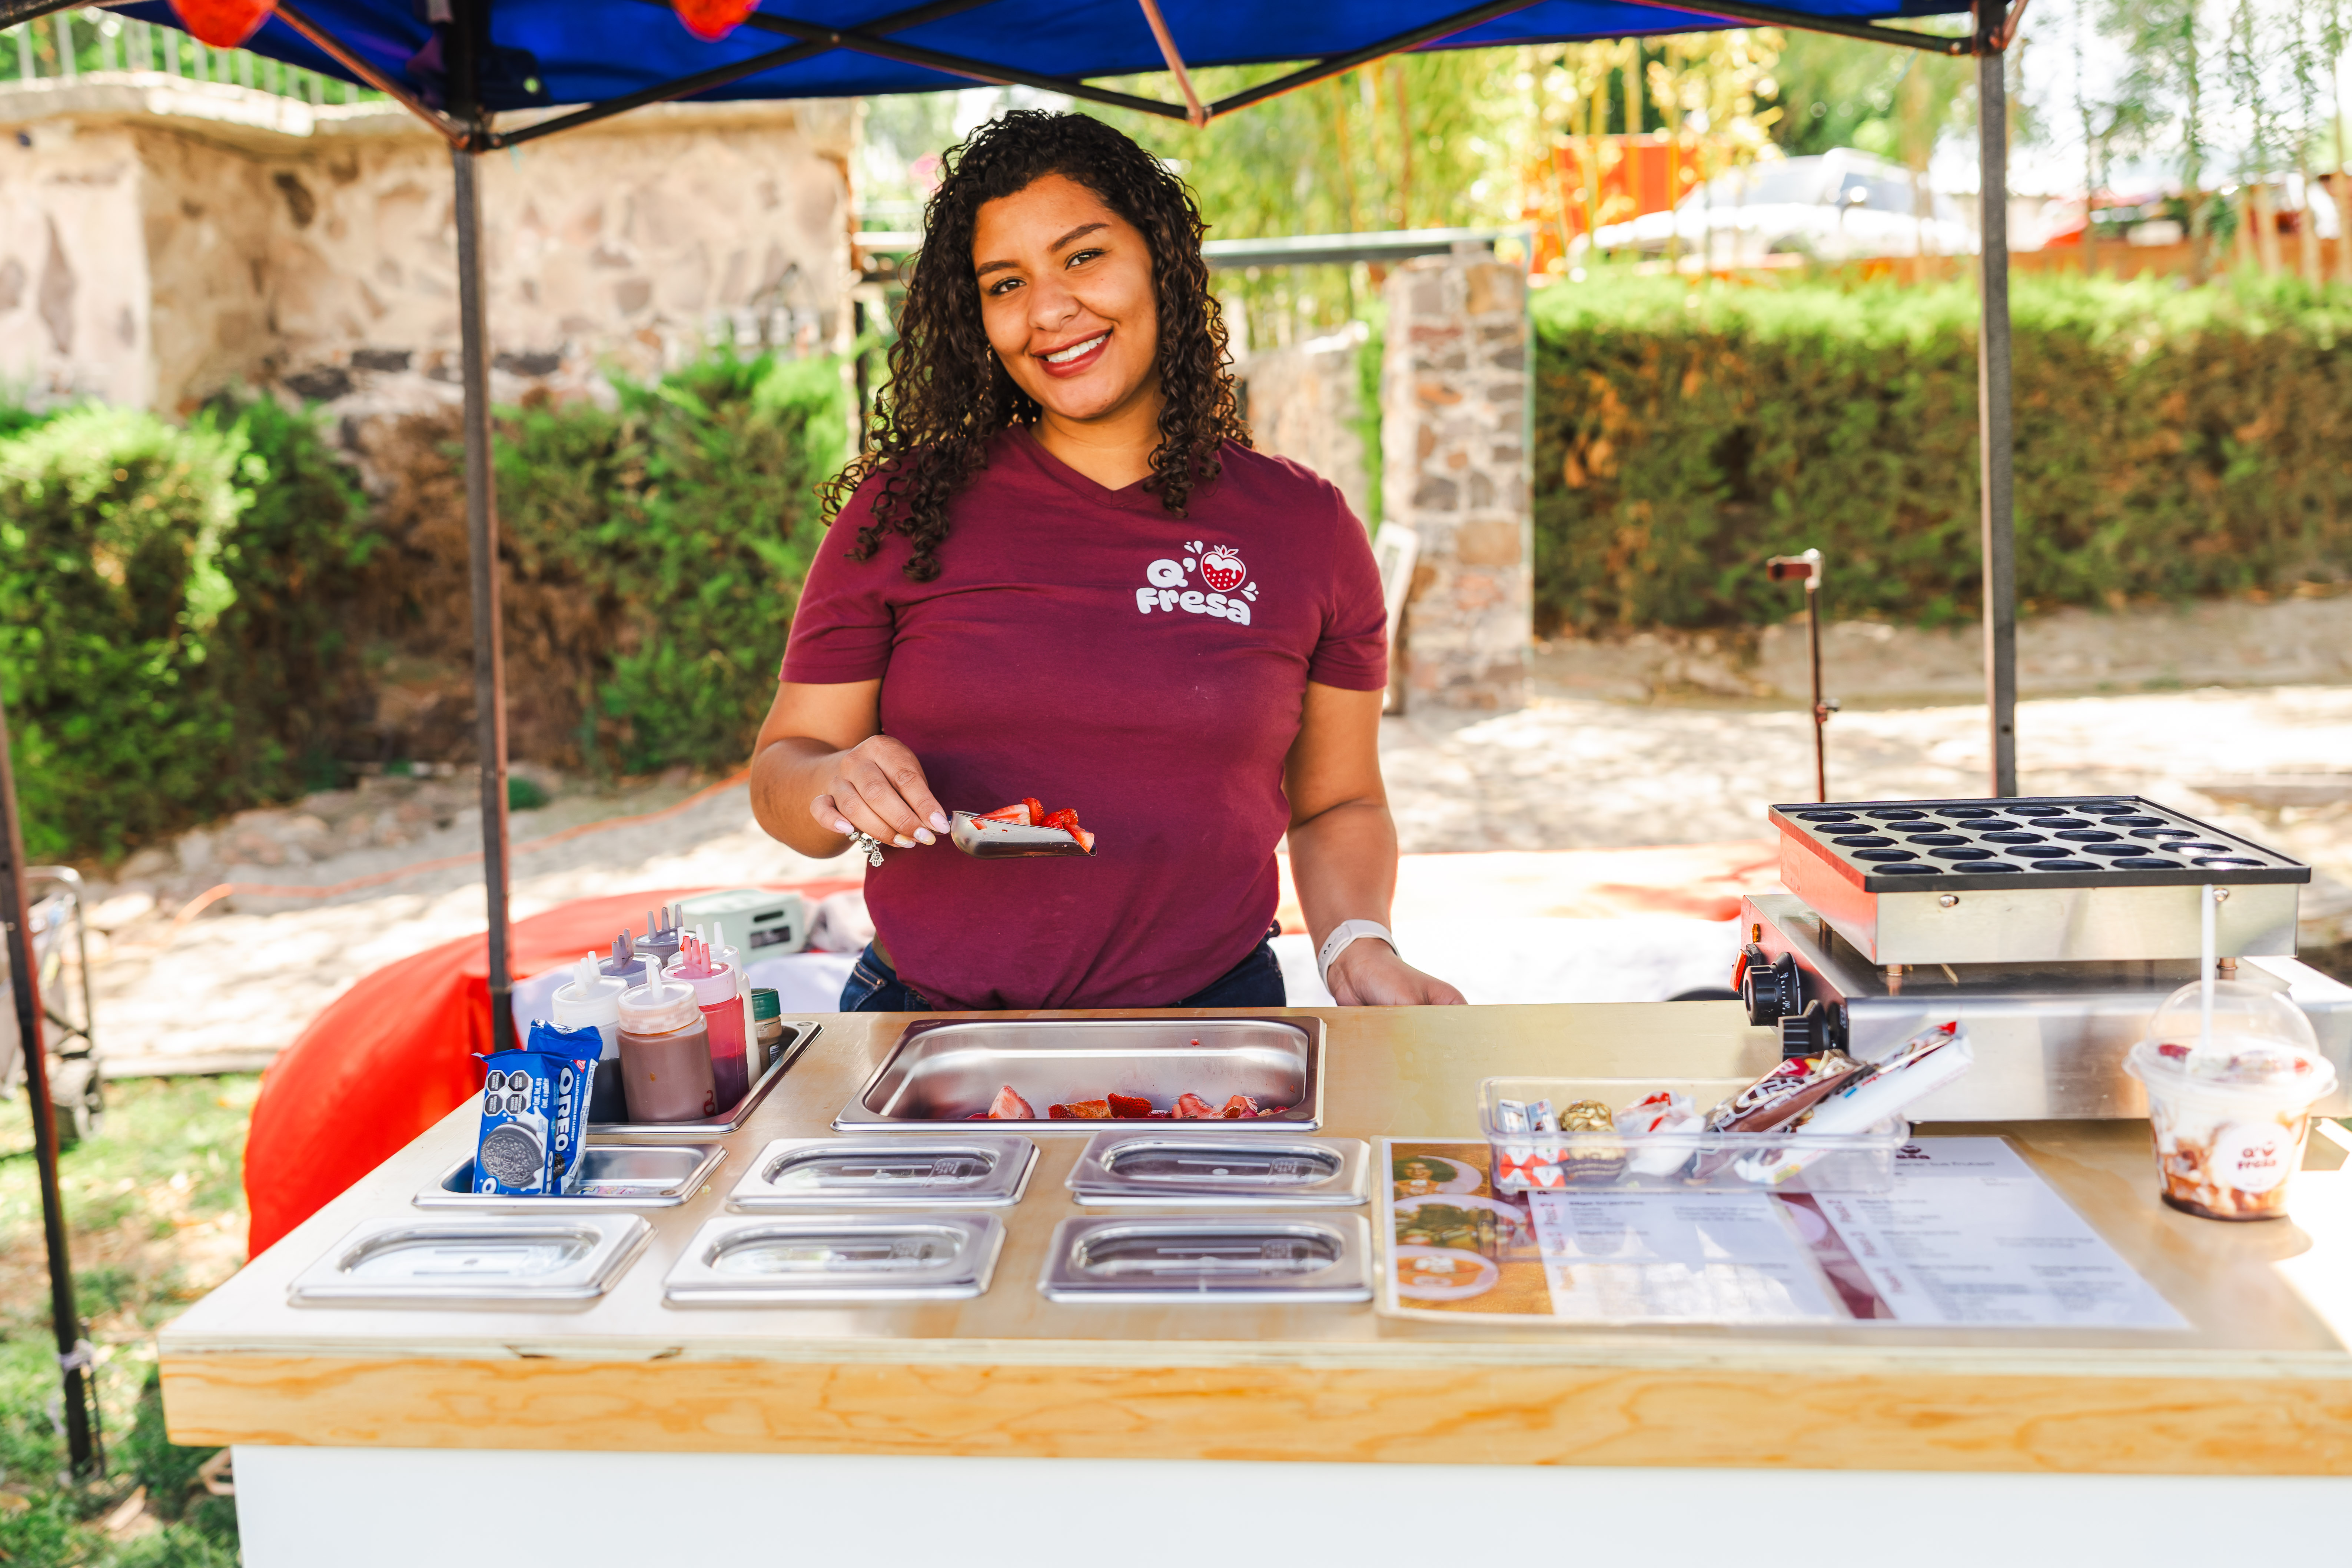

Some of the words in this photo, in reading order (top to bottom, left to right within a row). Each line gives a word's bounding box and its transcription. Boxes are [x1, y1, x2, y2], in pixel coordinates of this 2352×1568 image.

[1147, 557, 1196, 588] Q'
[1136, 587, 1251, 626] Fresa
[532, 1095, 541, 1106] Cont.
[540, 1098, 548, 1109] Cont.
[555, 1068, 574, 1152] OREO
[502, 1151, 512, 1170] OREO
